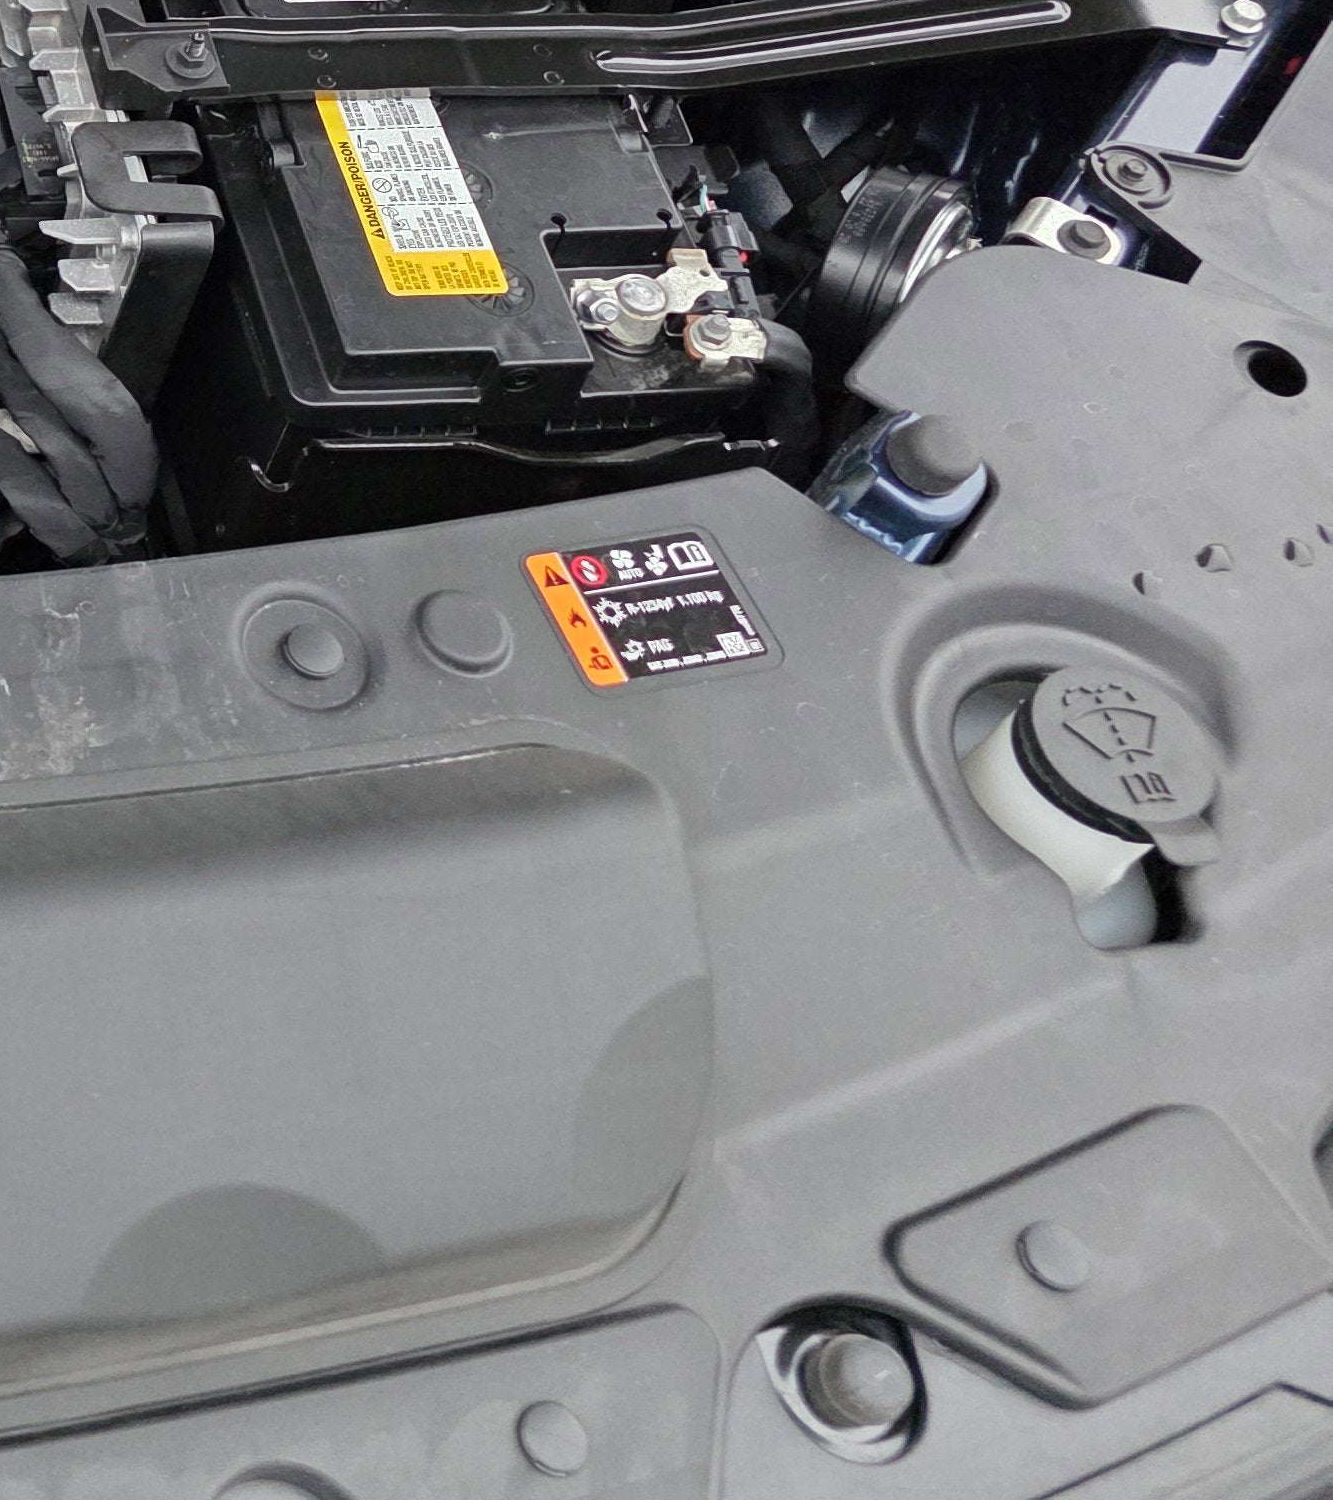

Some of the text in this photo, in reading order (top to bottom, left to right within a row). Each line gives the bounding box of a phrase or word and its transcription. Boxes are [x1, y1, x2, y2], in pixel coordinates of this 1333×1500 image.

[337, 141, 380, 227] DANGER/POISON
[619, 568, 644, 580] AUTO
[647, 638, 675, 654] PAG
